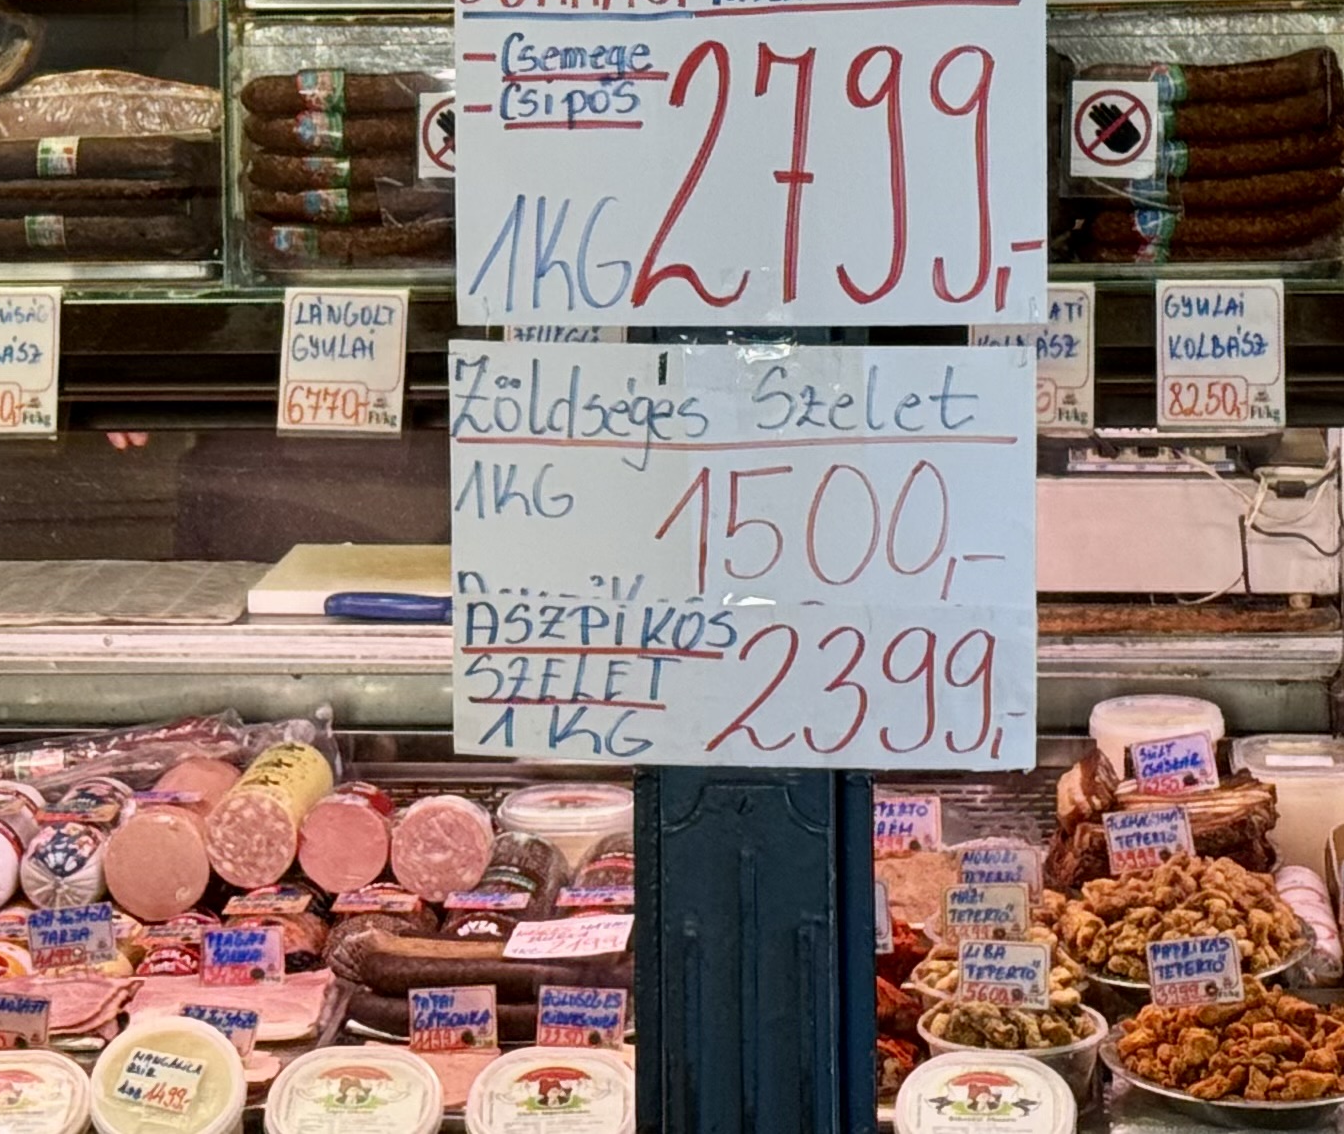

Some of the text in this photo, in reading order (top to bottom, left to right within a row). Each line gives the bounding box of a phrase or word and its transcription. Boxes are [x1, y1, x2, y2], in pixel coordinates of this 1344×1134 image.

[1164, 293, 1246, 319] GYULAI
[1167, 325, 1269, 361] KOLBÁSZ
[756, 364, 980, 430] Szelet
[464, 656, 682, 704] SZELET
